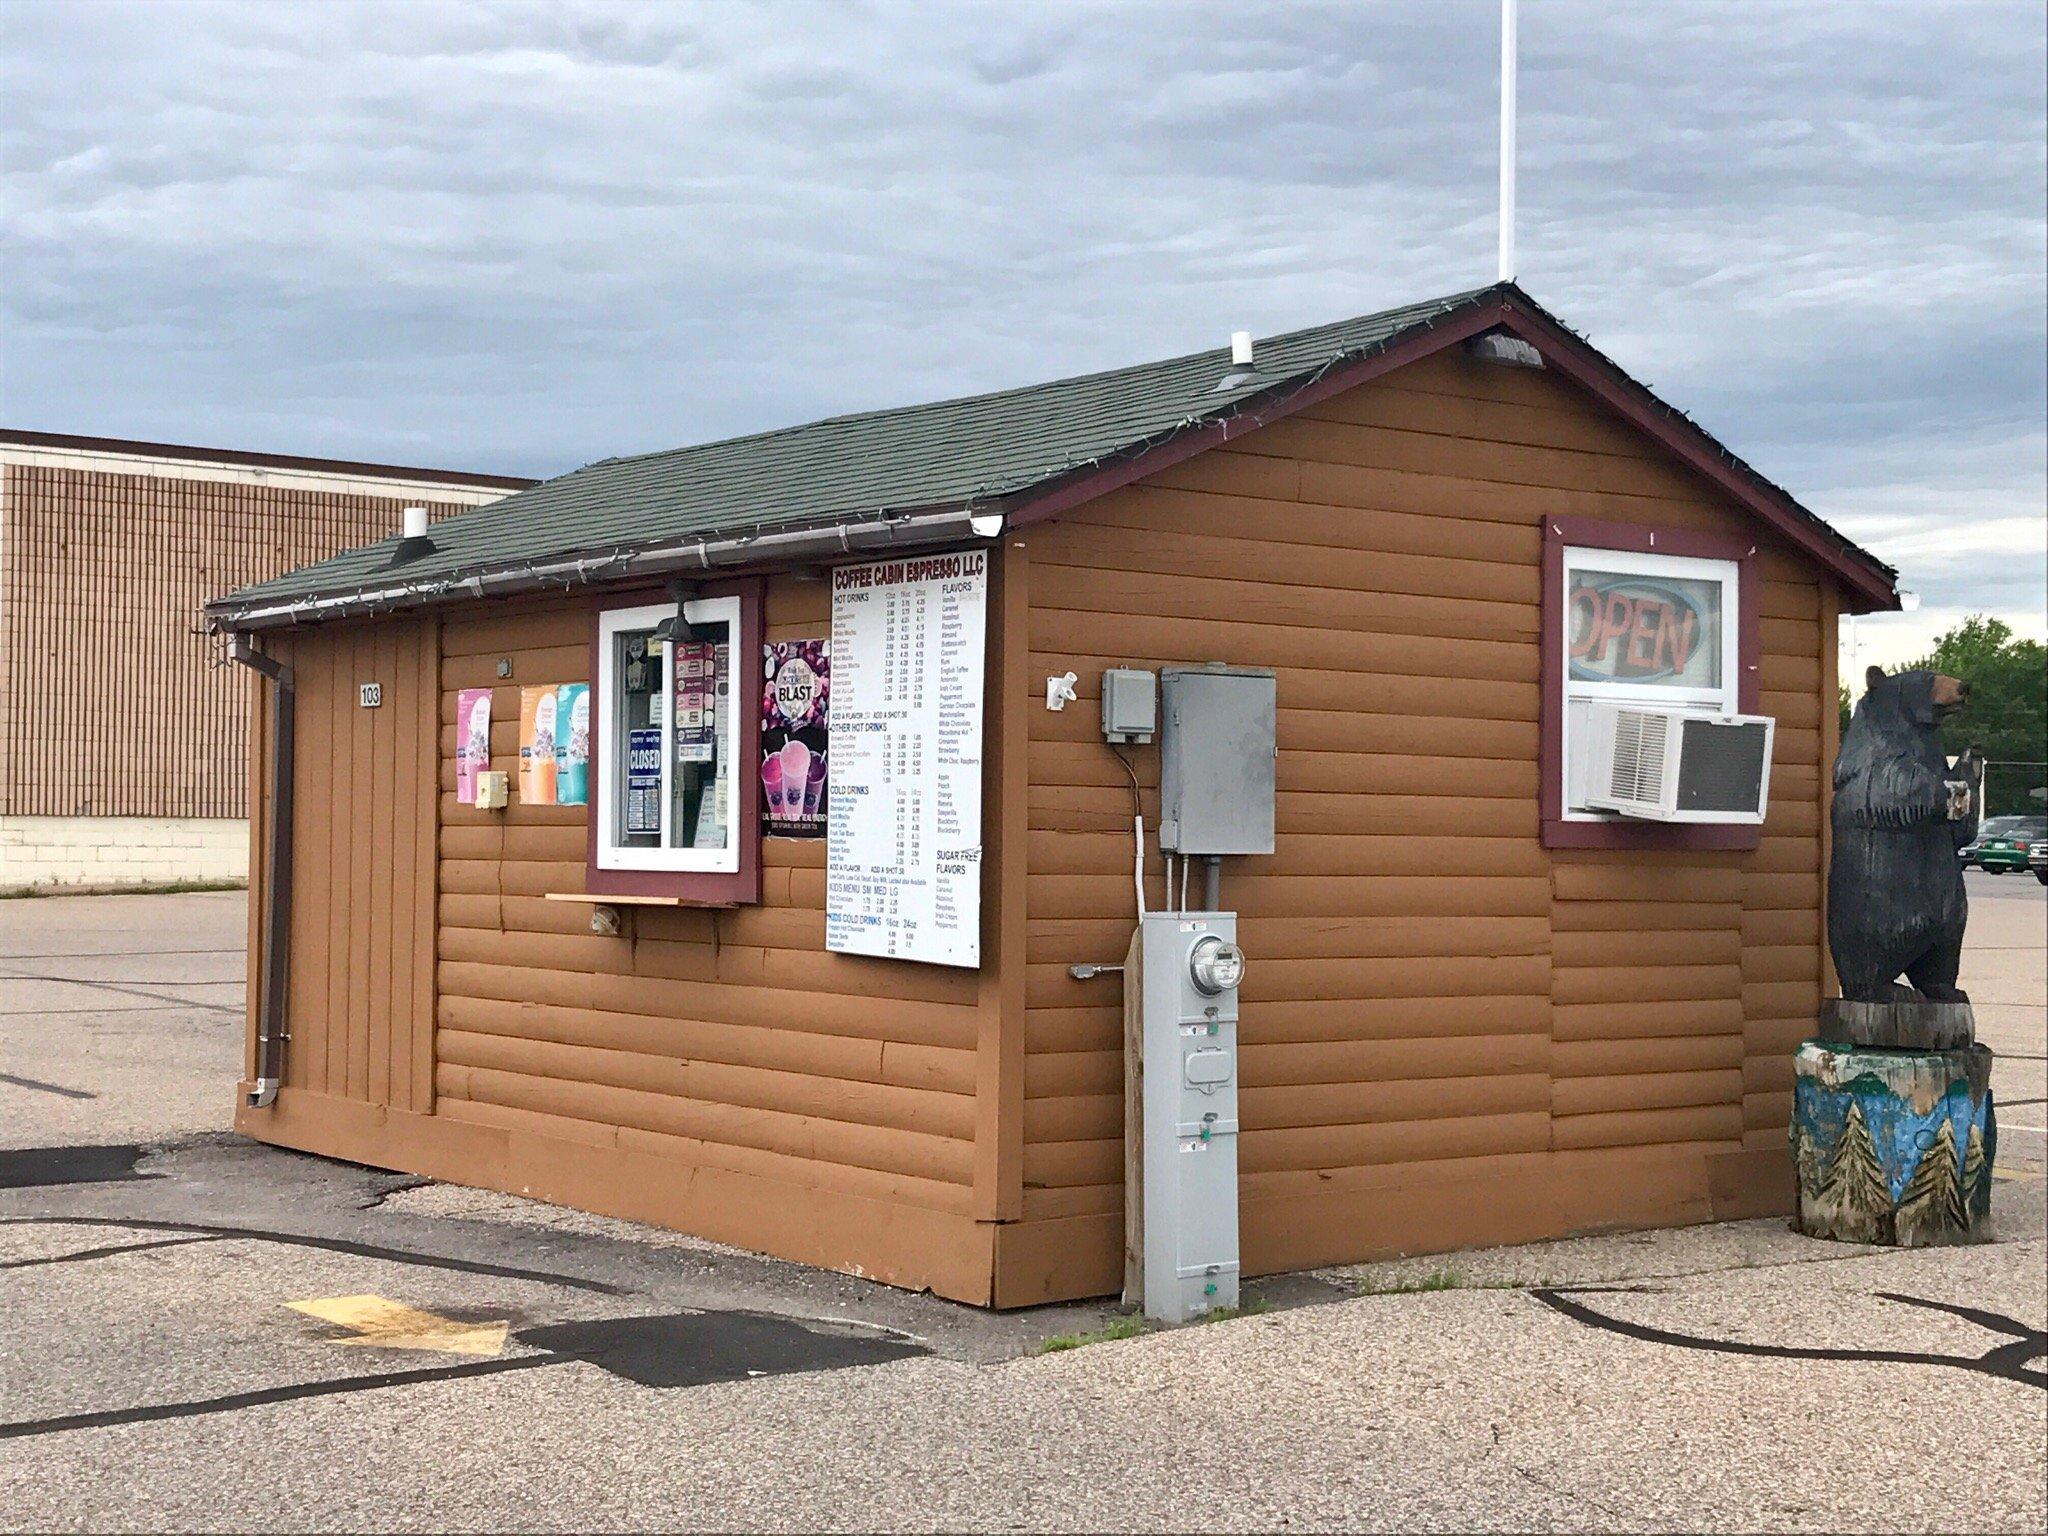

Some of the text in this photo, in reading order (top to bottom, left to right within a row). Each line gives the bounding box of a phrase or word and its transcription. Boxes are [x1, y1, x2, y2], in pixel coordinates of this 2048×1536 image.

[835, 554, 984, 590] COFFEE CABIN ESPRESSO LLC
[942, 582, 972, 594] FLAVORS
[834, 592, 870, 604] HOT DRINKS
[1569, 586, 1694, 675] OPEN
[362, 686, 380, 704] 103
[779, 686, 812, 702] BLAST
[832, 722, 888, 732] OTHER HOT DRINKS
[630, 749, 660, 770] CLOSED
[830, 786, 870, 795] COLD DRINKS
[936, 850, 978, 862] SUGAR FREE
[830, 864, 838, 872] ADD
[844, 864, 860, 872] FLAVOR
[936, 864, 966, 875] FLAVORS
[829, 883, 898, 896] KIDS MENU SM MED LG
[828, 913, 917, 929] KIDS COLD DRINKS 16oz 24oz
